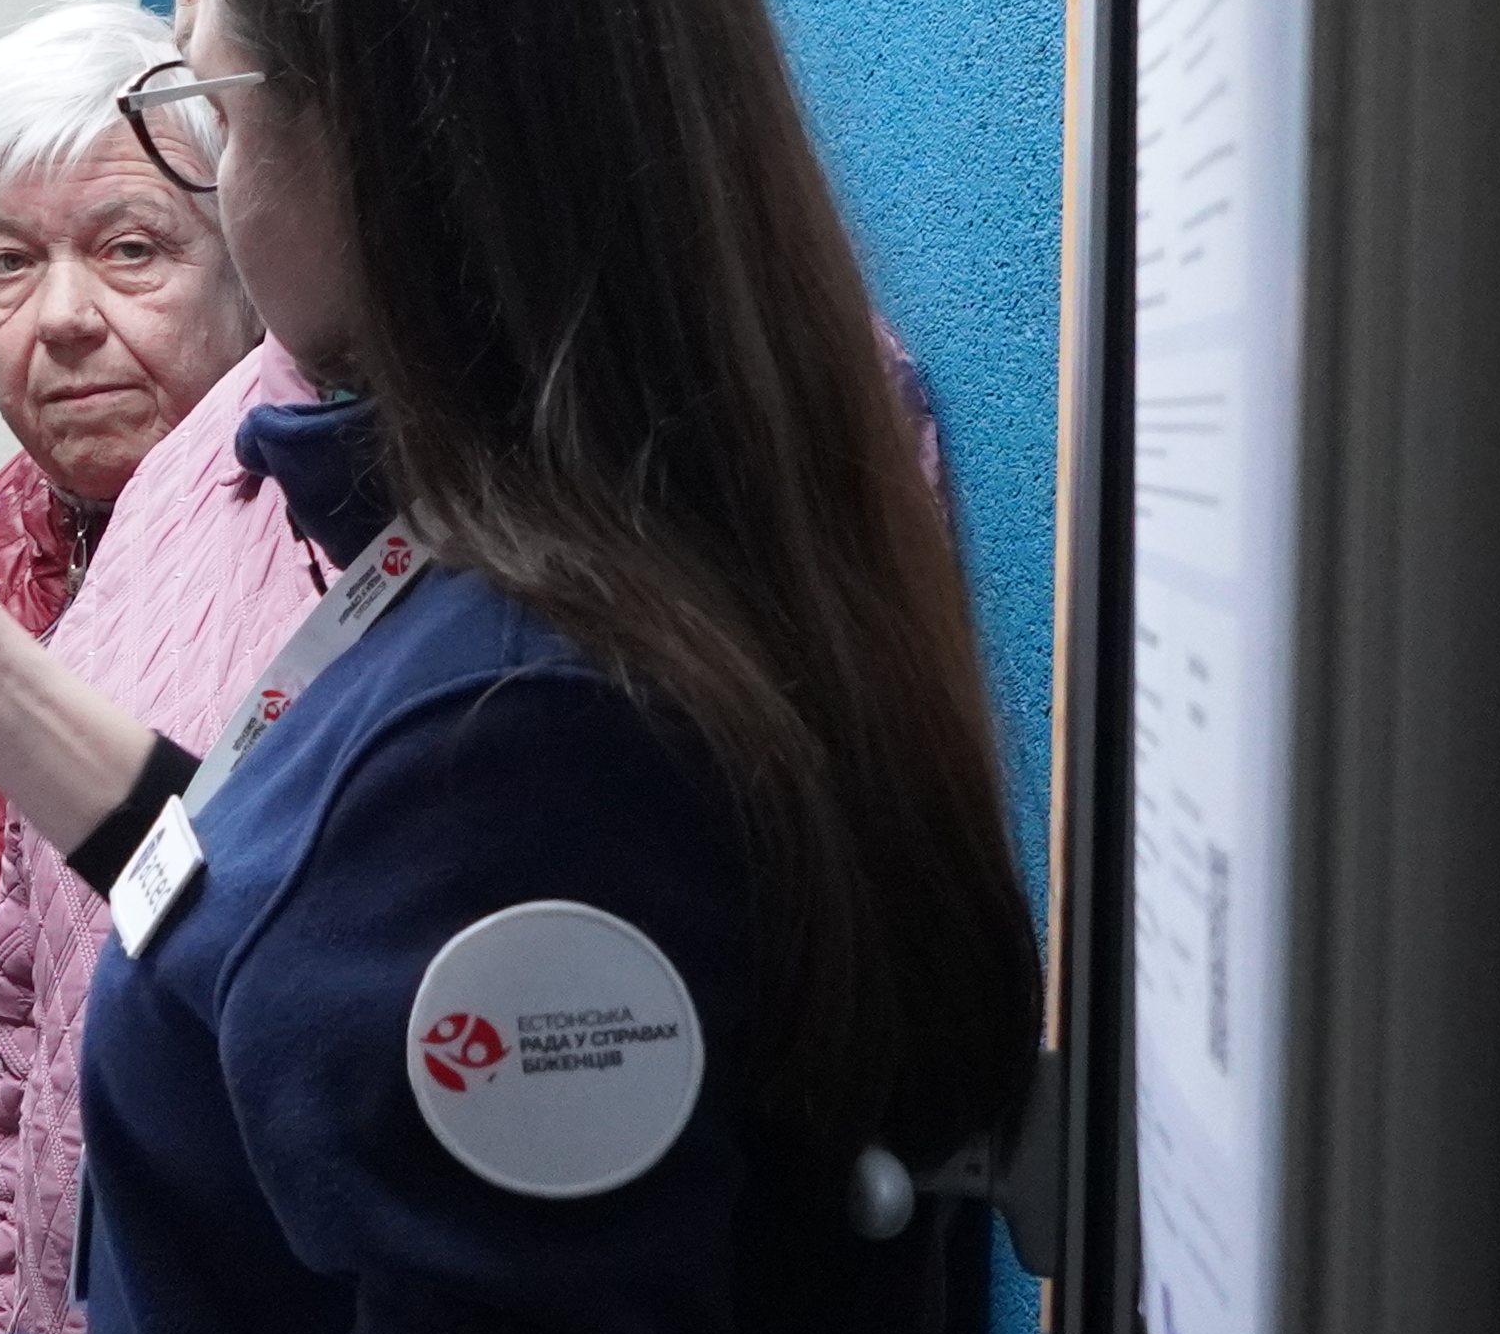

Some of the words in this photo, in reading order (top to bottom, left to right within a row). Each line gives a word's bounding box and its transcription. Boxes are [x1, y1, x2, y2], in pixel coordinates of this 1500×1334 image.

[519, 1032, 573, 1054] РАДА
[574, 1031, 588, 1049] У
[590, 1023, 679, 1047] СПРАВАХ
